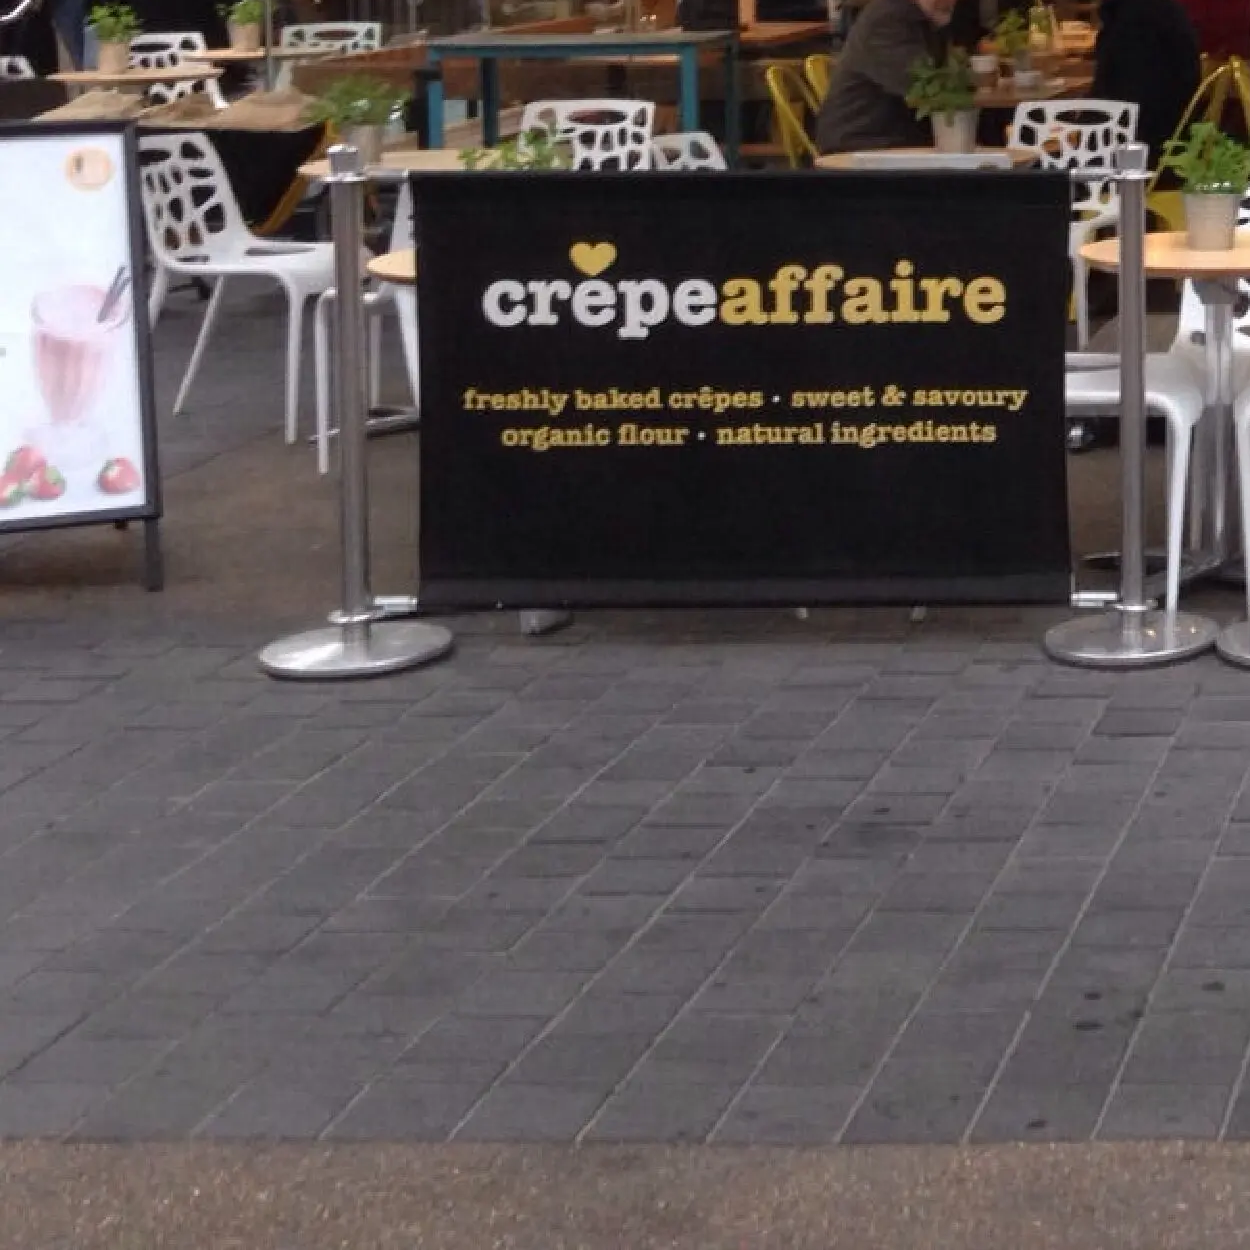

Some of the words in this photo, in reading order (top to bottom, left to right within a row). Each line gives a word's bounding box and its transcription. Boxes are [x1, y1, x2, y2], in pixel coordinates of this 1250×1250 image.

[463, 388, 567, 414] freshly
[574, 387, 662, 411] baked
[668, 385, 764, 413] crêpes
[791, 386, 875, 409] sweet
[880, 384, 907, 408] &
[912, 387, 1028, 412] savoury
[501, 423, 610, 452] organic
[618, 423, 690, 446] flour
[715, 422, 825, 445] natural
[830, 420, 997, 449] ingredients
